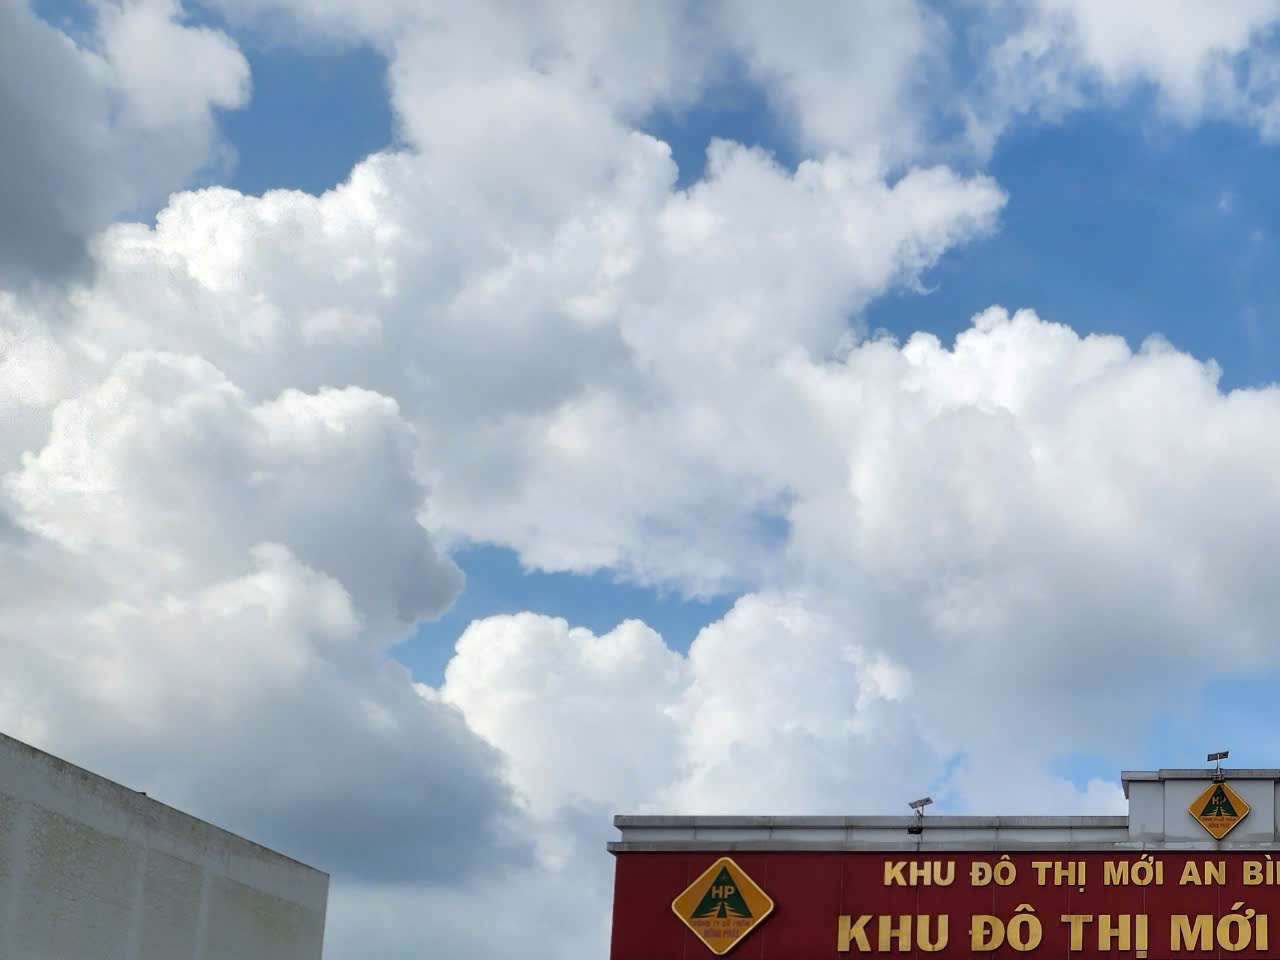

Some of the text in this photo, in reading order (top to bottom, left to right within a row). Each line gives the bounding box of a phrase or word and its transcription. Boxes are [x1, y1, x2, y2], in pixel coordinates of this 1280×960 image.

[711, 885, 736, 899] HP
[883, 861, 956, 886] KHU
[969, 855, 1017, 887] ĐÔ
[1031, 861, 1086, 893] THỊ
[1103, 854, 1164, 886] MỚI
[1179, 861, 1226, 886] AN
[837, 914, 949, 952] KHU
[968, 903, 1043, 952] ĐÔ
[1060, 914, 1149, 959] THỊ
[1170, 901, 1268, 951] MỚI
